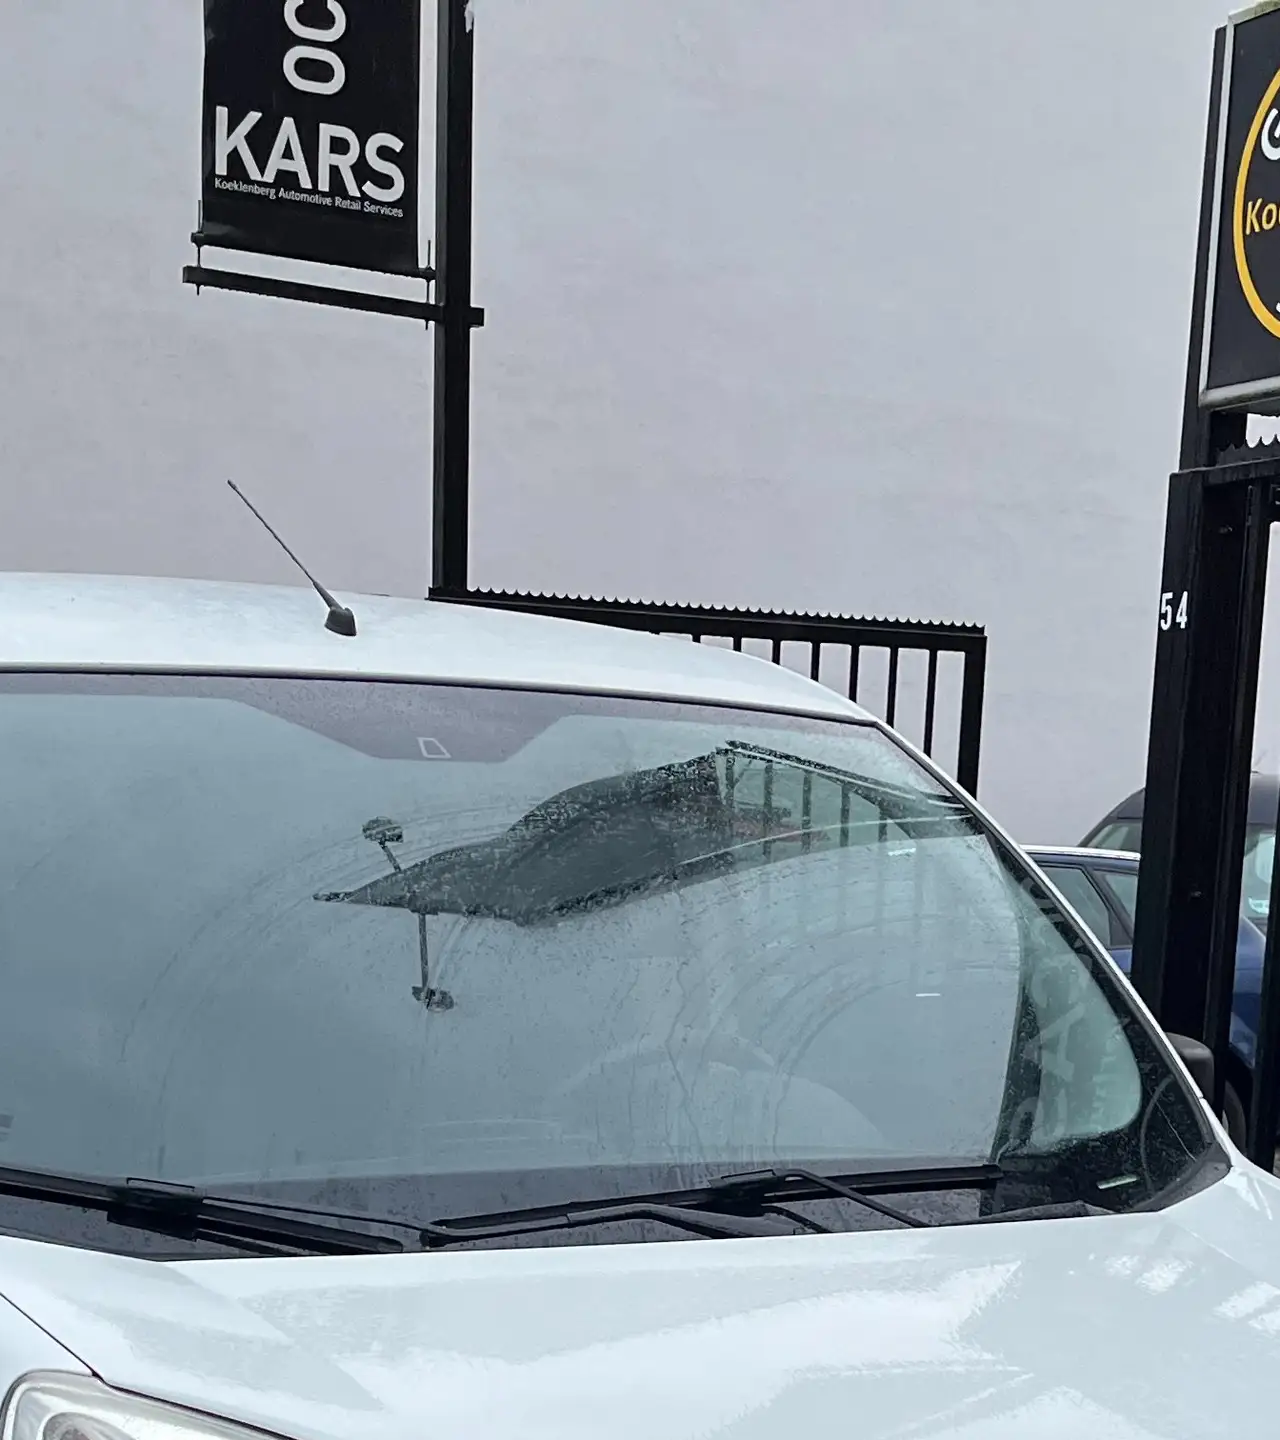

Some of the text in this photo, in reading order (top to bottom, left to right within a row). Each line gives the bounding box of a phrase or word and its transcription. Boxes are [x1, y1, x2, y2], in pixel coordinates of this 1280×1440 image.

[215, 105, 405, 202] KARS
[214, 177, 404, 218] Koeklenberg Automotive Retail Services
[1160, 591, 1188, 631] 54
